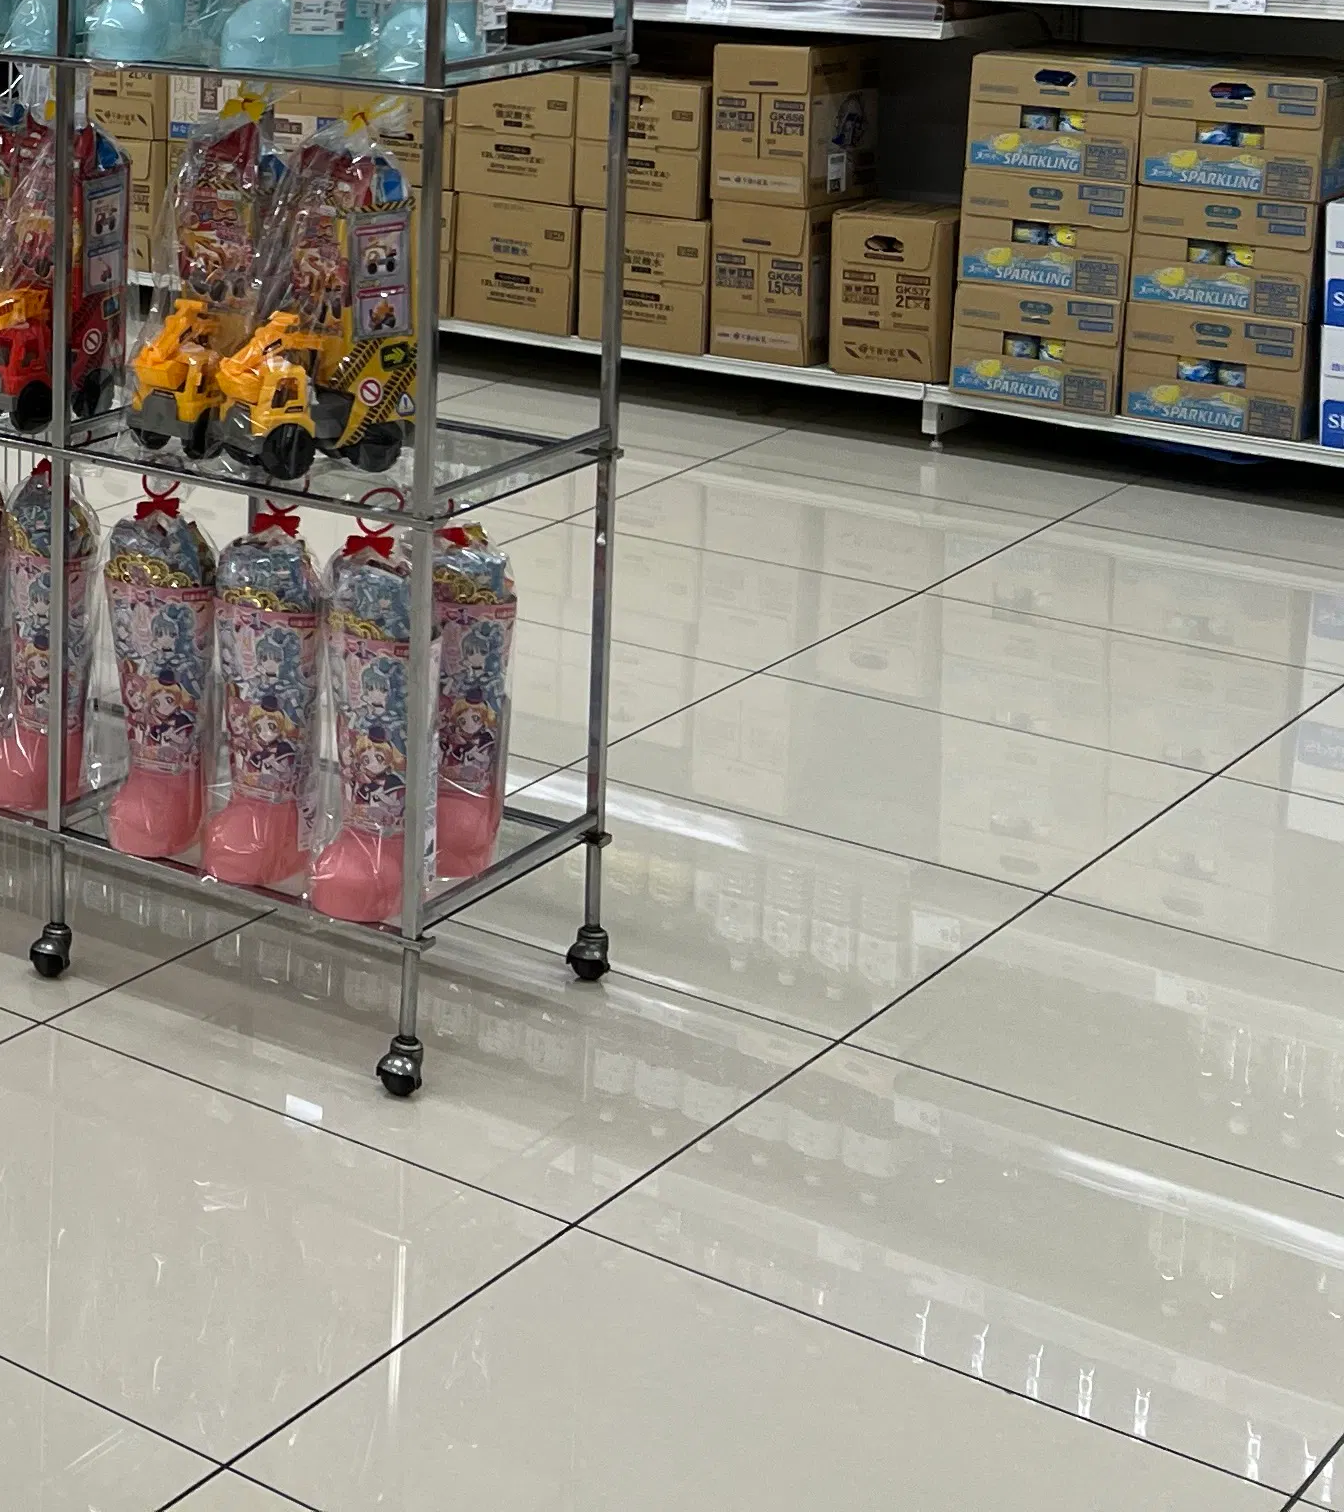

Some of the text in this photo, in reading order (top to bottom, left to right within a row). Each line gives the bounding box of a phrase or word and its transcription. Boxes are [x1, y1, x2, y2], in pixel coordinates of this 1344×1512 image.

[1003, 150, 1081, 173] SPARKLING
[1178, 169, 1260, 192] SPARKLING
[994, 264, 1072, 287] SPARKLING
[1167, 286, 1249, 310] SPARKLING
[984, 376, 1059, 401] SPARKLING
[1159, 403, 1242, 430] SPARKLING
